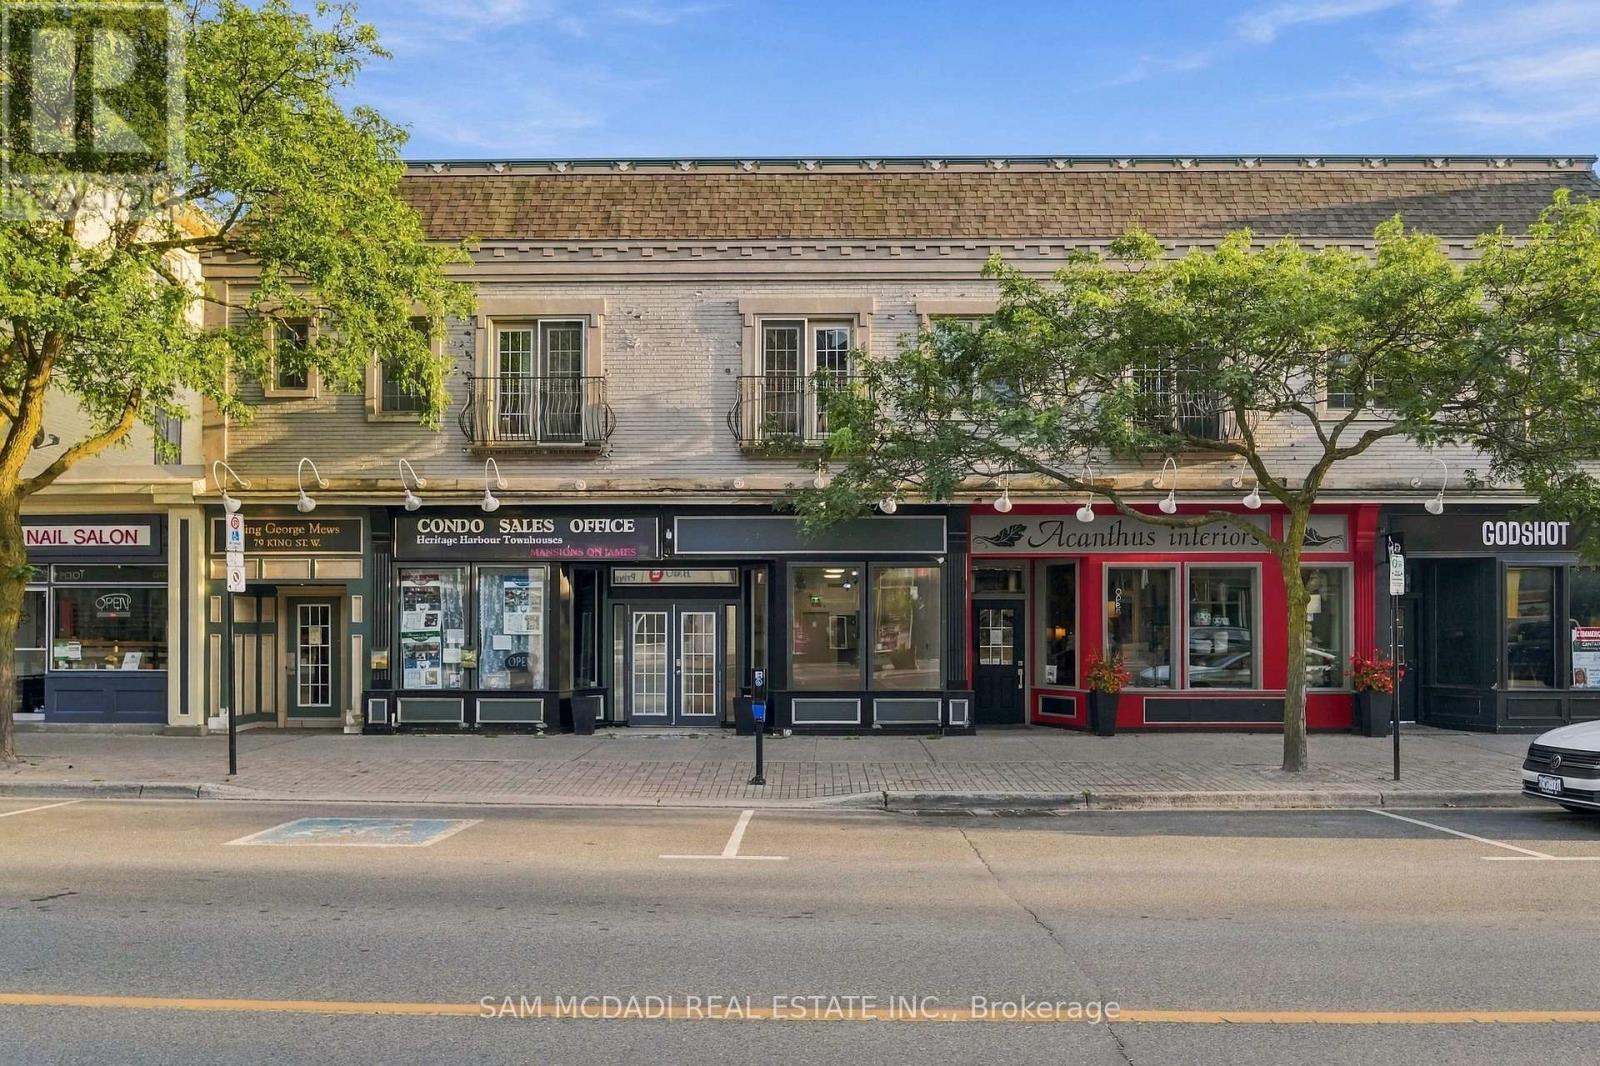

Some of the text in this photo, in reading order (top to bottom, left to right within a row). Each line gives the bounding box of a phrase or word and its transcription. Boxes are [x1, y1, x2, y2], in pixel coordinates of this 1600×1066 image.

[244, 522, 341, 536] ing George Mews
[417, 518, 635, 533] CONDO SALES OFFICE
[26, 529, 139, 544] NAIL SALON
[416, 535, 563, 546] Heritage Harbour Townhouses
[1028, 520, 1260, 548] Acanthus interiors
[1482, 521, 1570, 546] GODSHOT
[254, 538, 264, 547] 79
[267, 538, 292, 547] KING
[96, 595, 131, 611] OPEN
